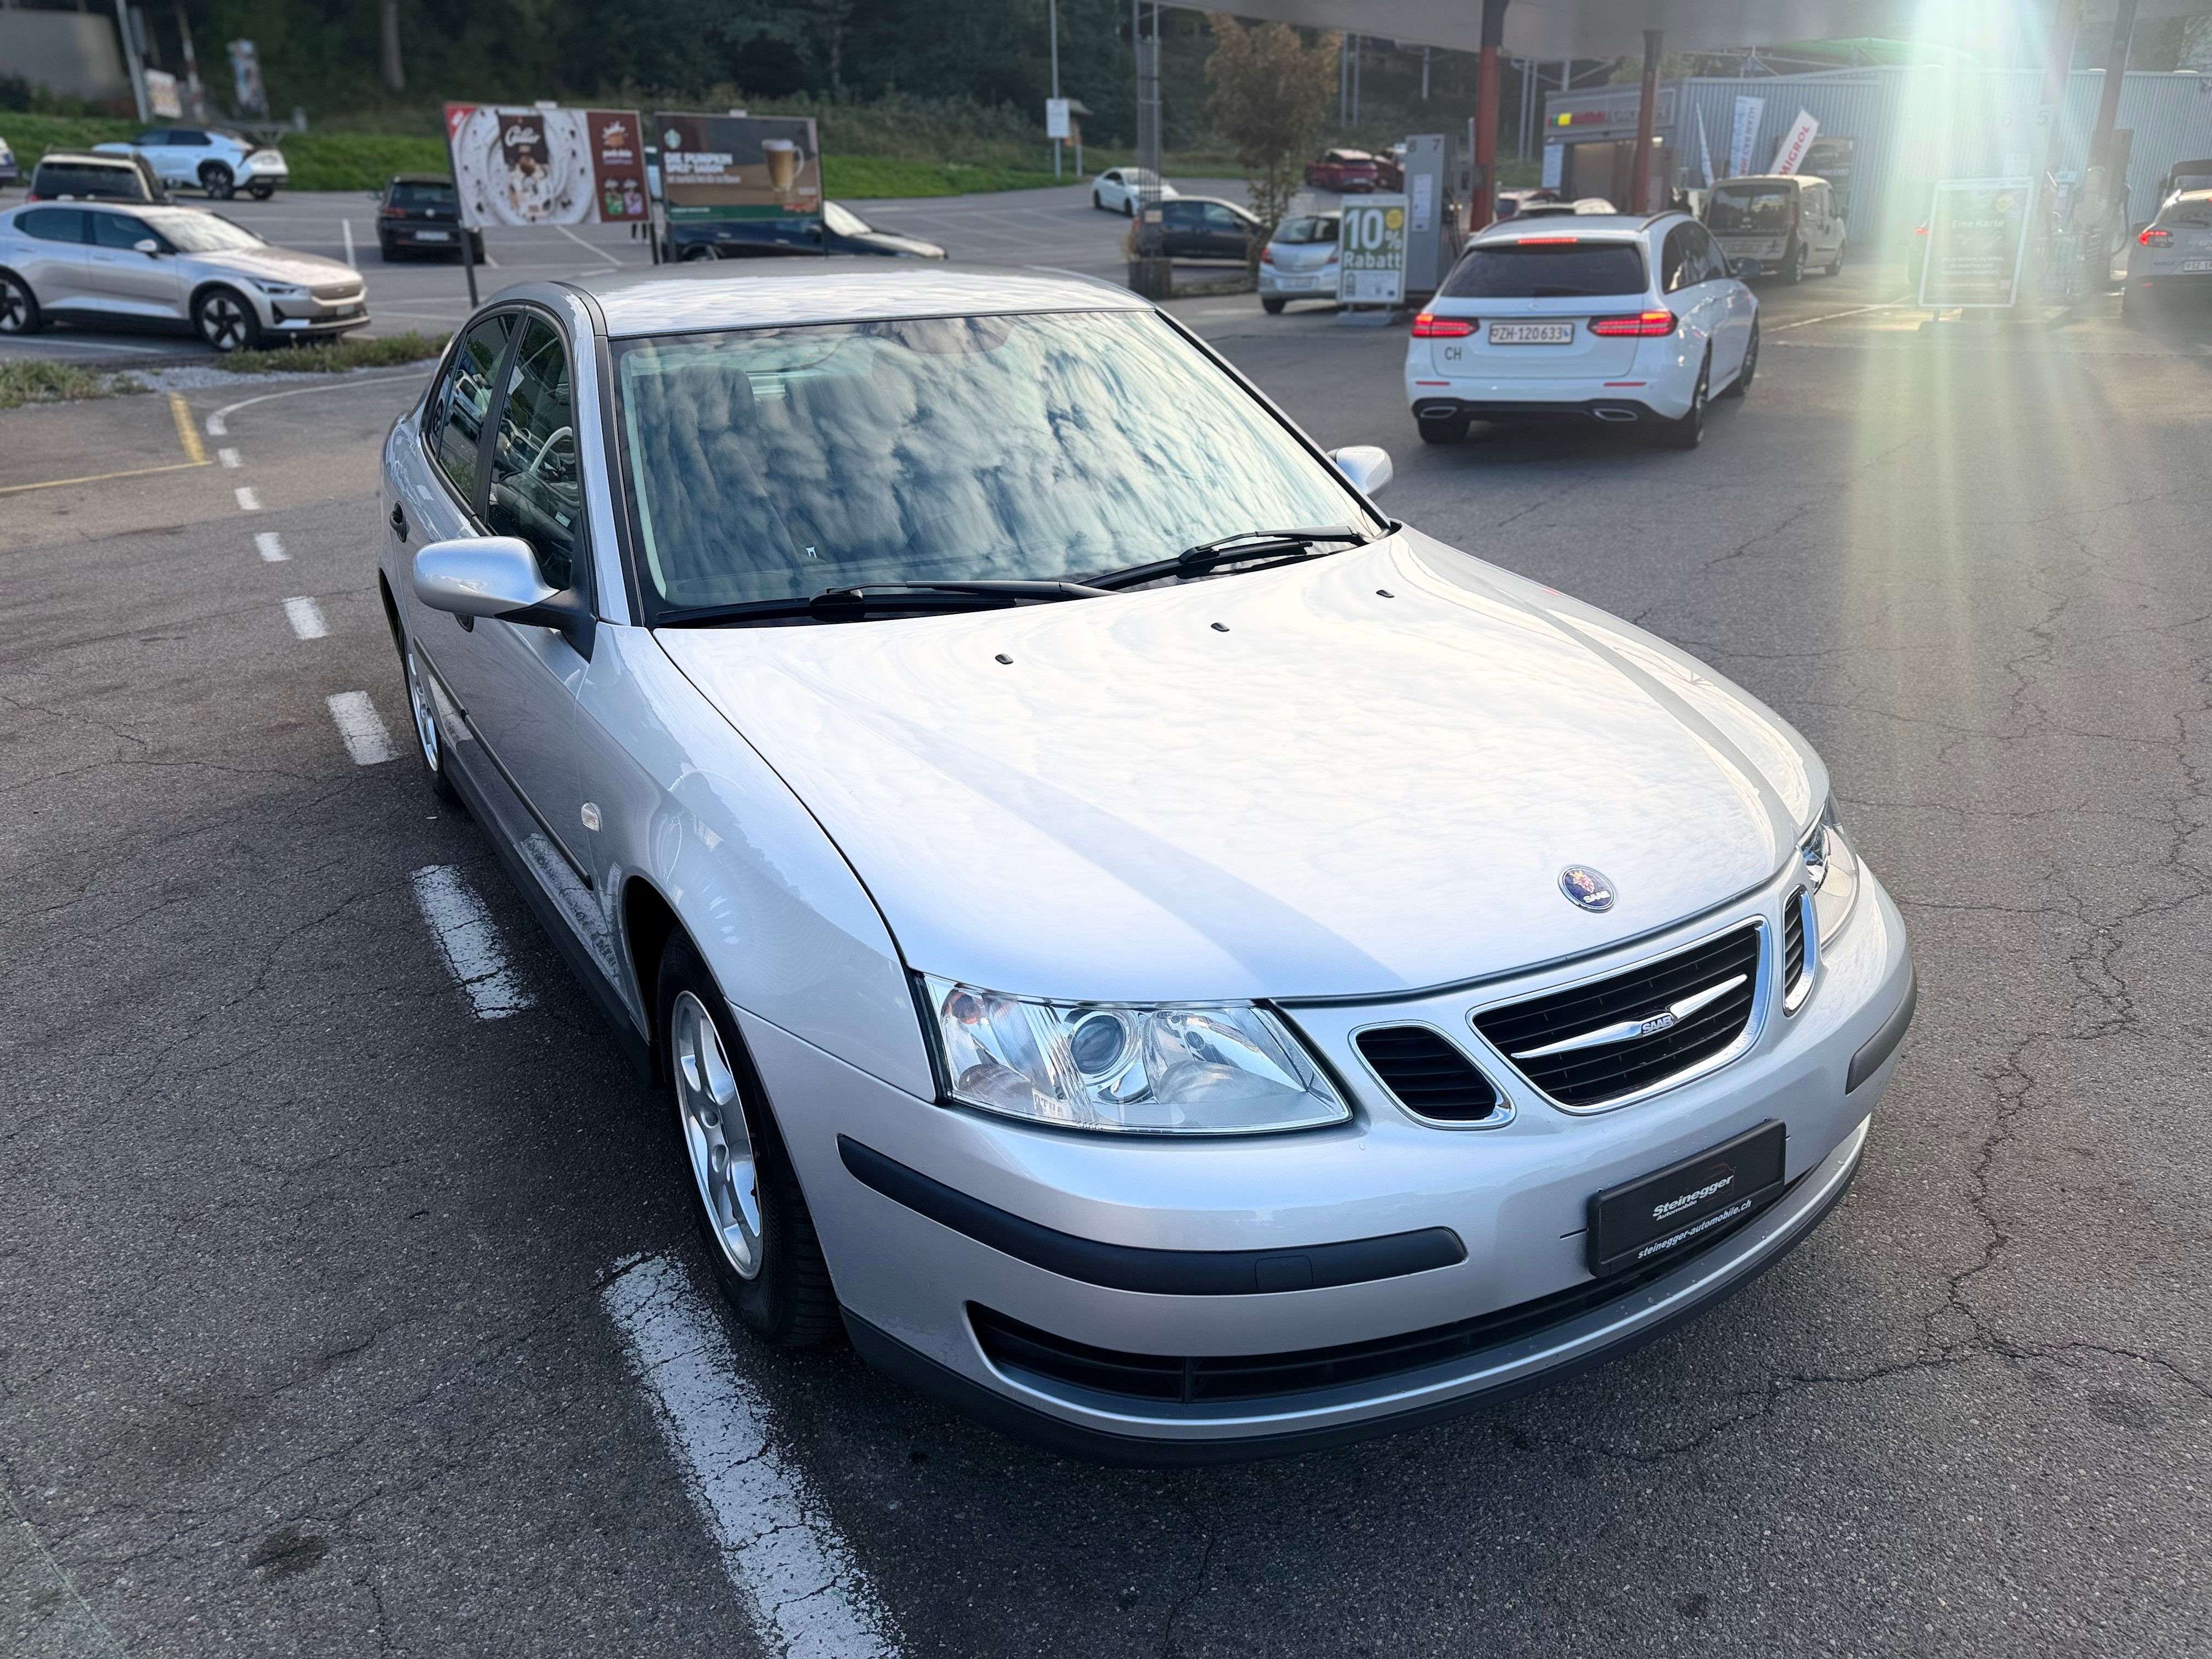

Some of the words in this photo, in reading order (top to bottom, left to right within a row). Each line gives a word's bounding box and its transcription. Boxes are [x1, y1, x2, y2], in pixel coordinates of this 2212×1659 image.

[2036, 110, 2050, 126] 5
[1408, 139, 1417, 153] 8
[1432, 139, 1441, 151] 7
[1778, 125, 1810, 175] MIGROL
[1952, 219, 1974, 229] Eine
[1976, 219, 2005, 228] Karte
[1345, 251, 1401, 269] Rabatt
[1444, 347, 1462, 360] CH
[1583, 890, 1611, 903] SAAB
[1642, 1015, 1672, 1035] SAAB
[1652, 1175, 1734, 1217] Steinegger
[1656, 1200, 1697, 1221] Automobile
[1637, 1199, 1752, 1259] steinegger-automobile.ch
